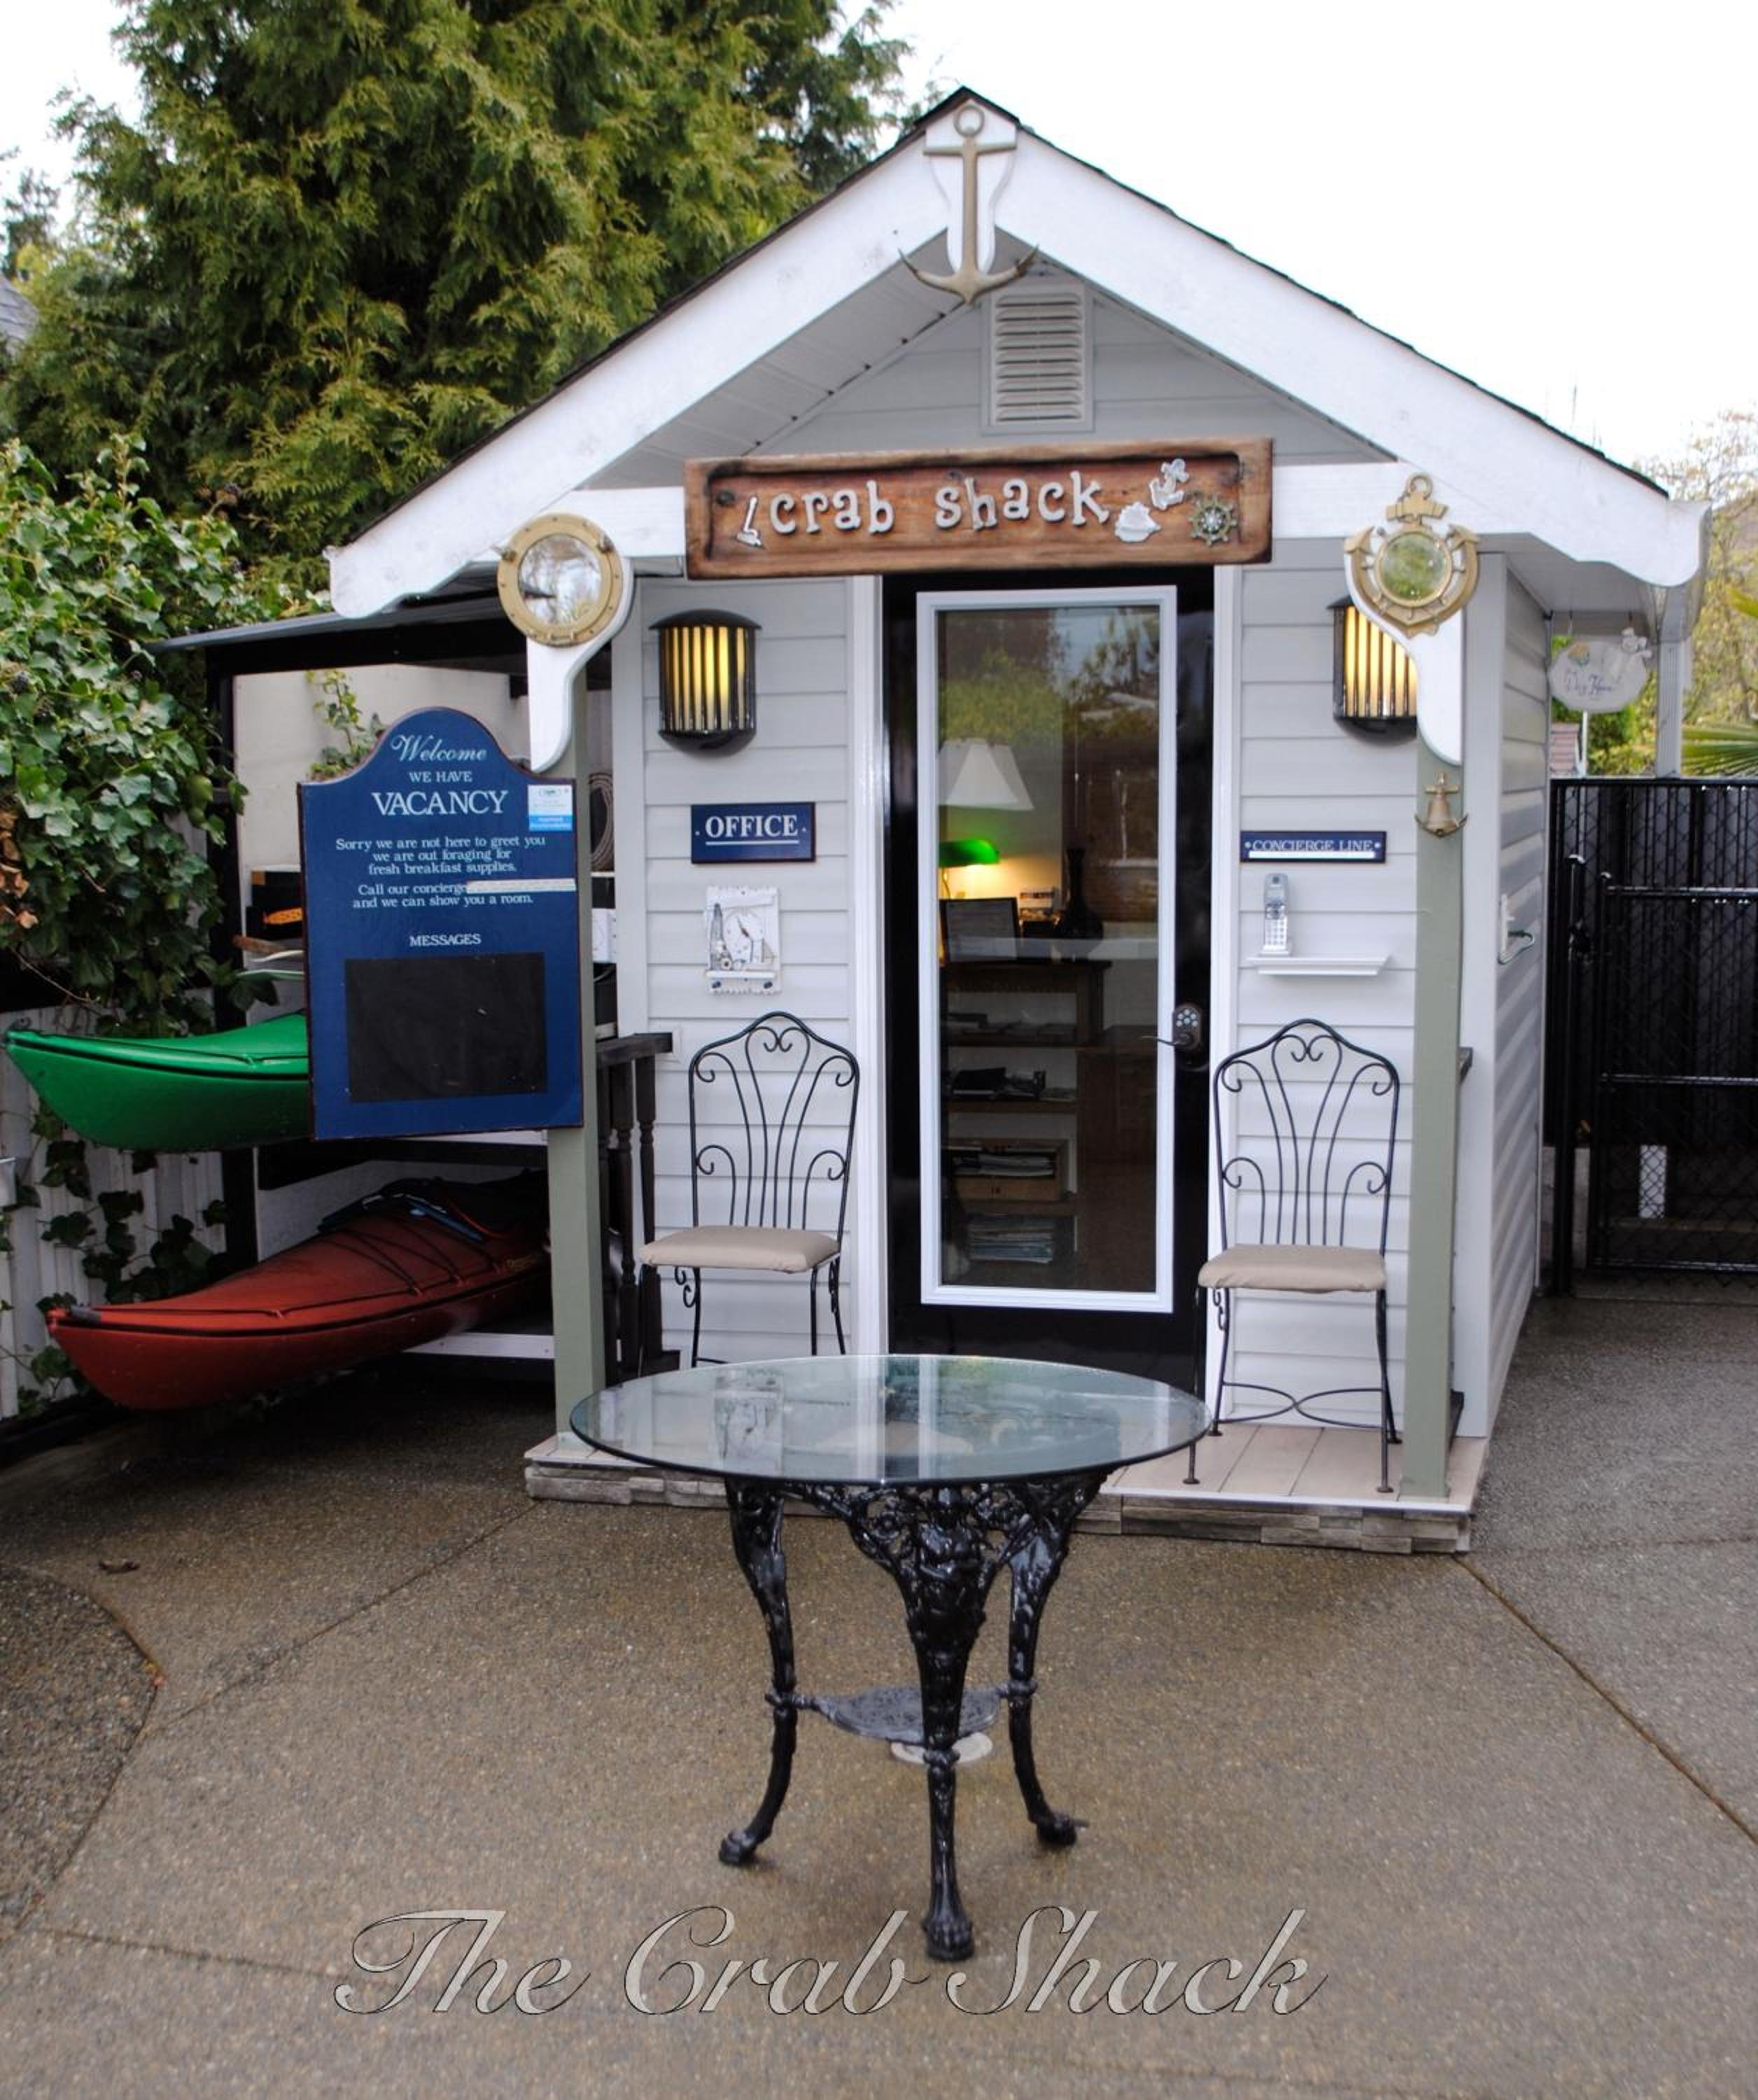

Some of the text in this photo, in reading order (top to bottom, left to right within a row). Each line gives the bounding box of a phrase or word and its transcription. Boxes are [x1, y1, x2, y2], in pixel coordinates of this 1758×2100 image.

[769, 470, 1111, 536] crab shack
[390, 734, 488, 762] Welcome
[408, 771, 474, 783] WE HAVE
[371, 790, 509, 816] VACANCY
[705, 814, 799, 839] OFFICE
[336, 836, 546, 852] Sorry we are not here to greet you
[1253, 840, 1373, 852] CONCIERGE LINE
[372, 848, 512, 862] we are out foraging for
[369, 861, 517, 875] fresh breakfast supplies.
[358, 883, 467, 895] Call our concierge
[353, 895, 534, 909] and we can show you a room.
[409, 933, 482, 947] MESSAGES
